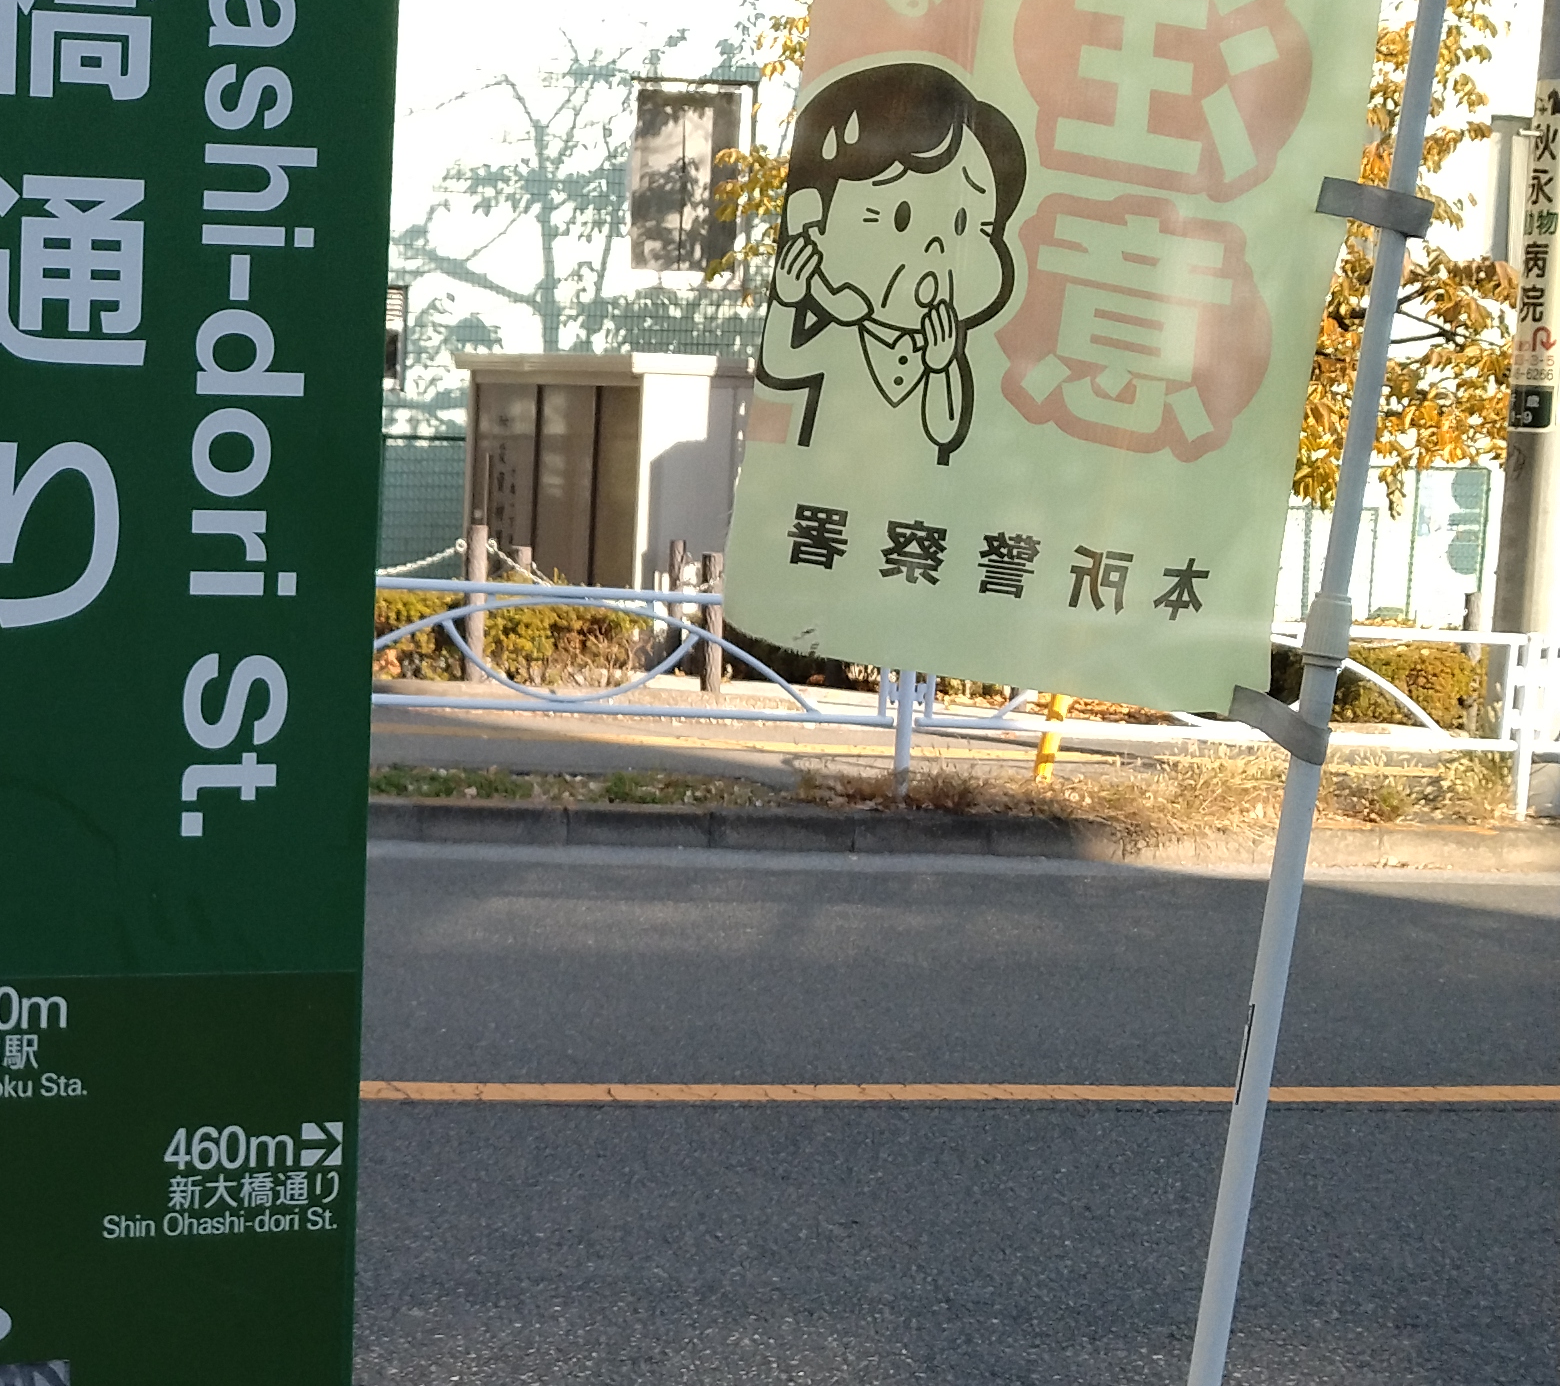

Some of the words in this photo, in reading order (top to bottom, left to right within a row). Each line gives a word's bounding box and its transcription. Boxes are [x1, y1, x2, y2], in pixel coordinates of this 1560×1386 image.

[180, 653, 288, 837] St.
[40, 1072, 88, 1097] Sta.
[163, 1124, 295, 1170] 460m
[168, 1171, 340, 1211] 新大橋通り
[102, 1214, 156, 1239] Shin
[163, 1207, 300, 1237] Ohashi-dori
[306, 1206, 338, 1231] St.
